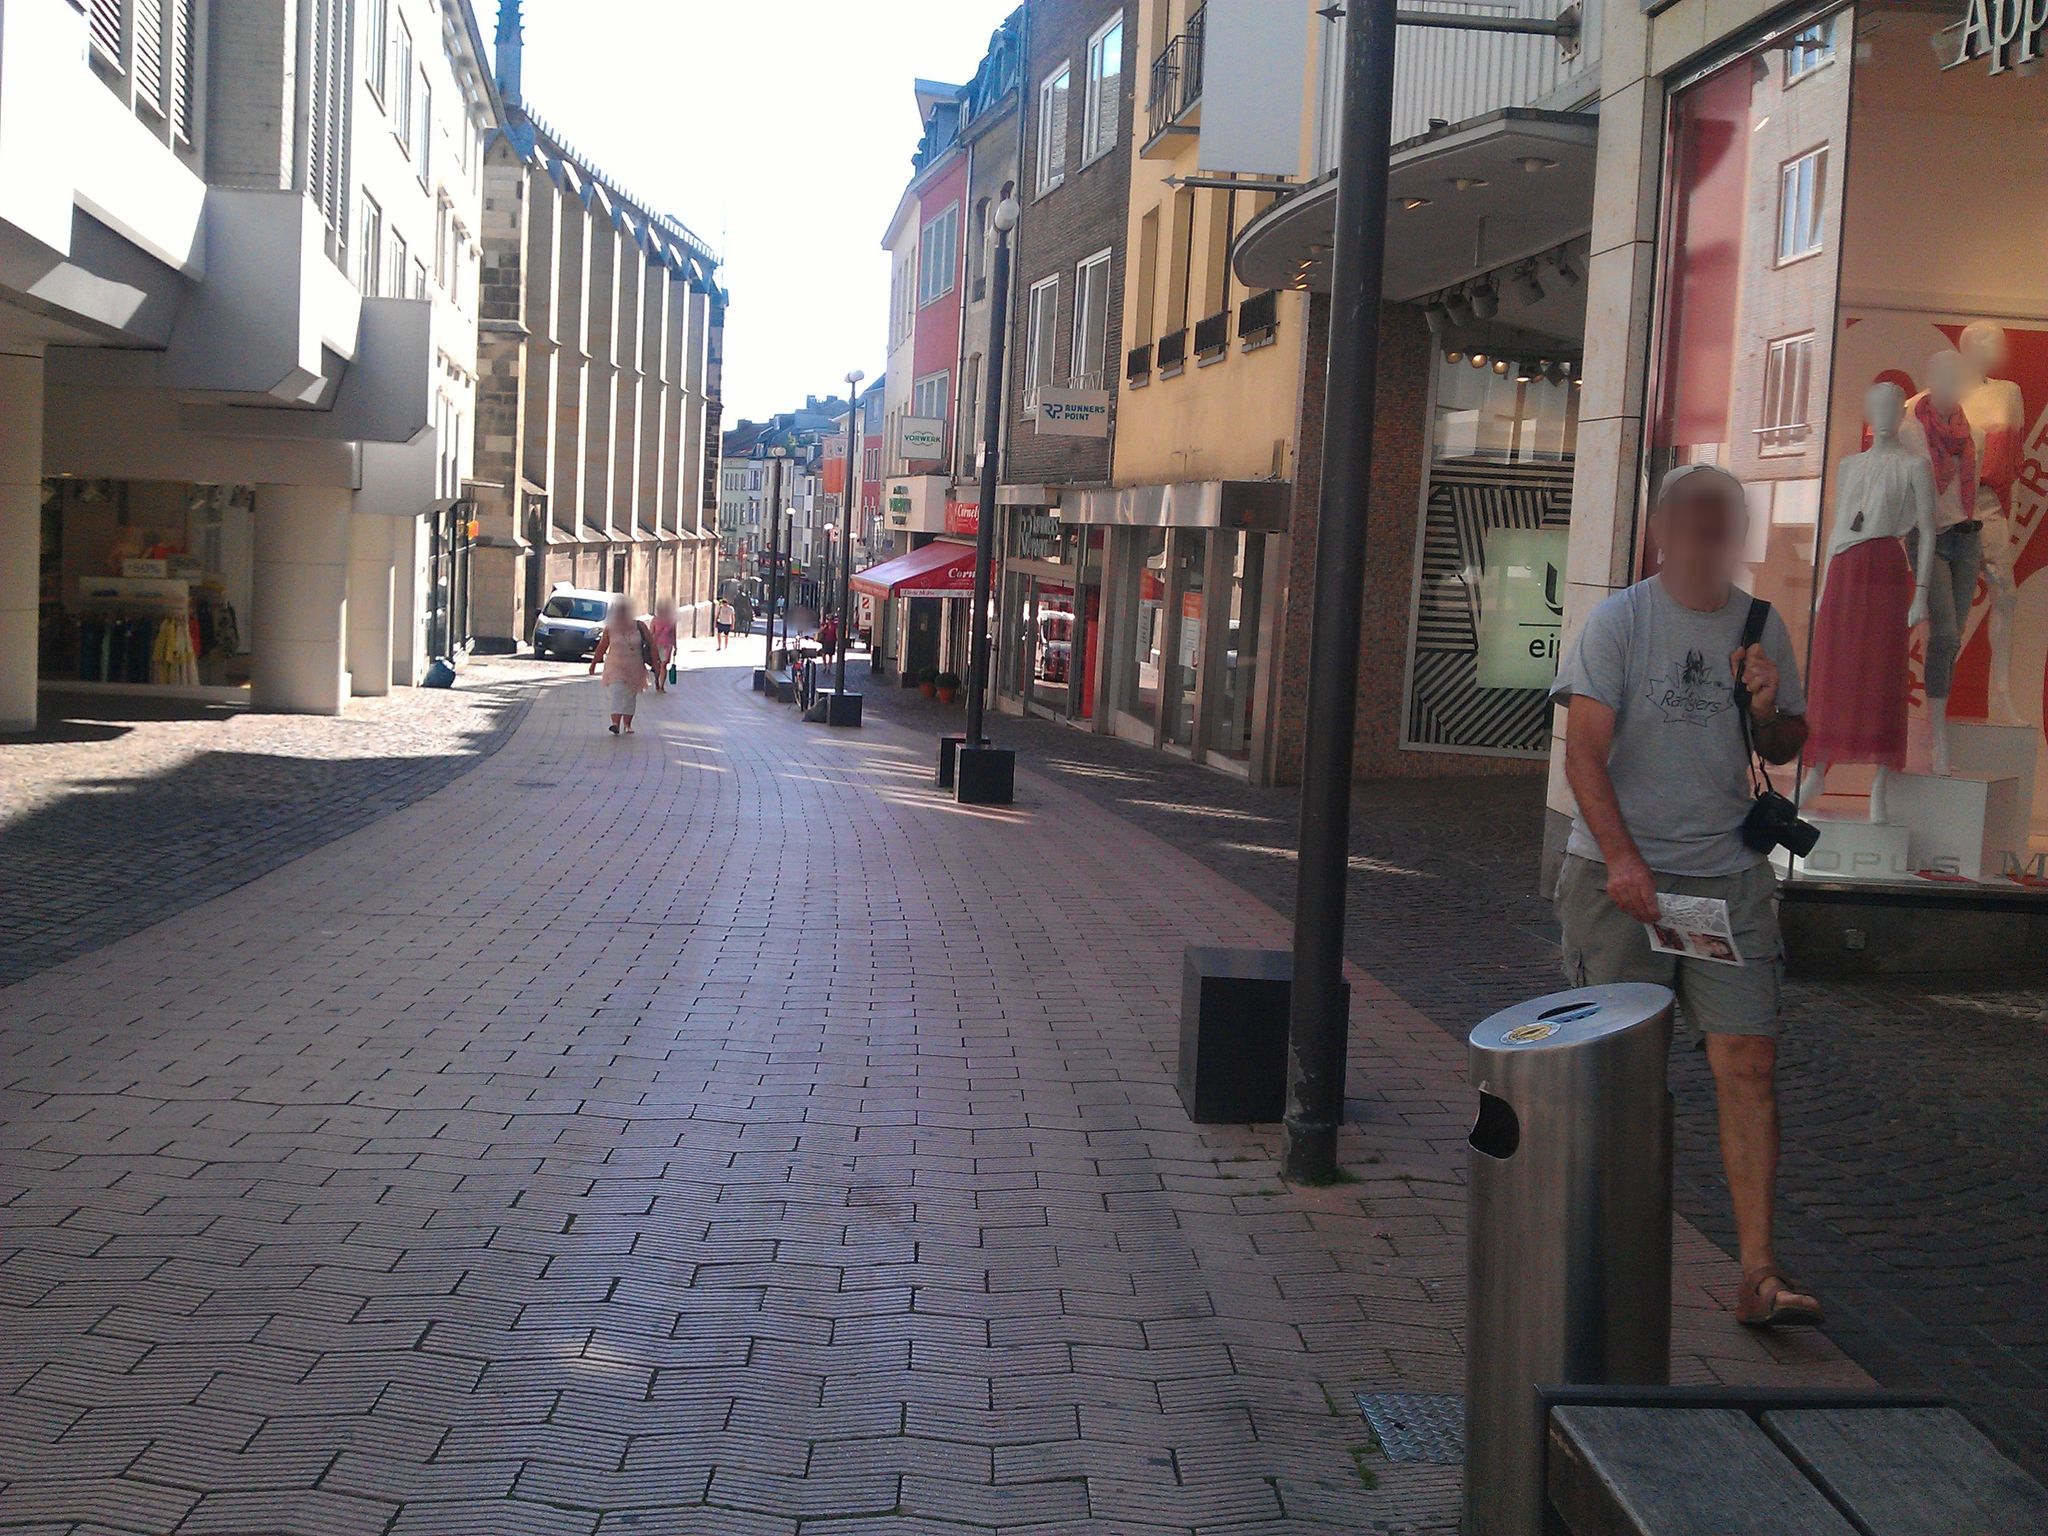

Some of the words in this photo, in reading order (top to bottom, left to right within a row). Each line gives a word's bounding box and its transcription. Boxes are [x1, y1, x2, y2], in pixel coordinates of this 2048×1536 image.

[1065, 404, 1106, 414] RUNNERS
[1064, 412, 1089, 420] POINT
[904, 434, 941, 443] VORWERK
